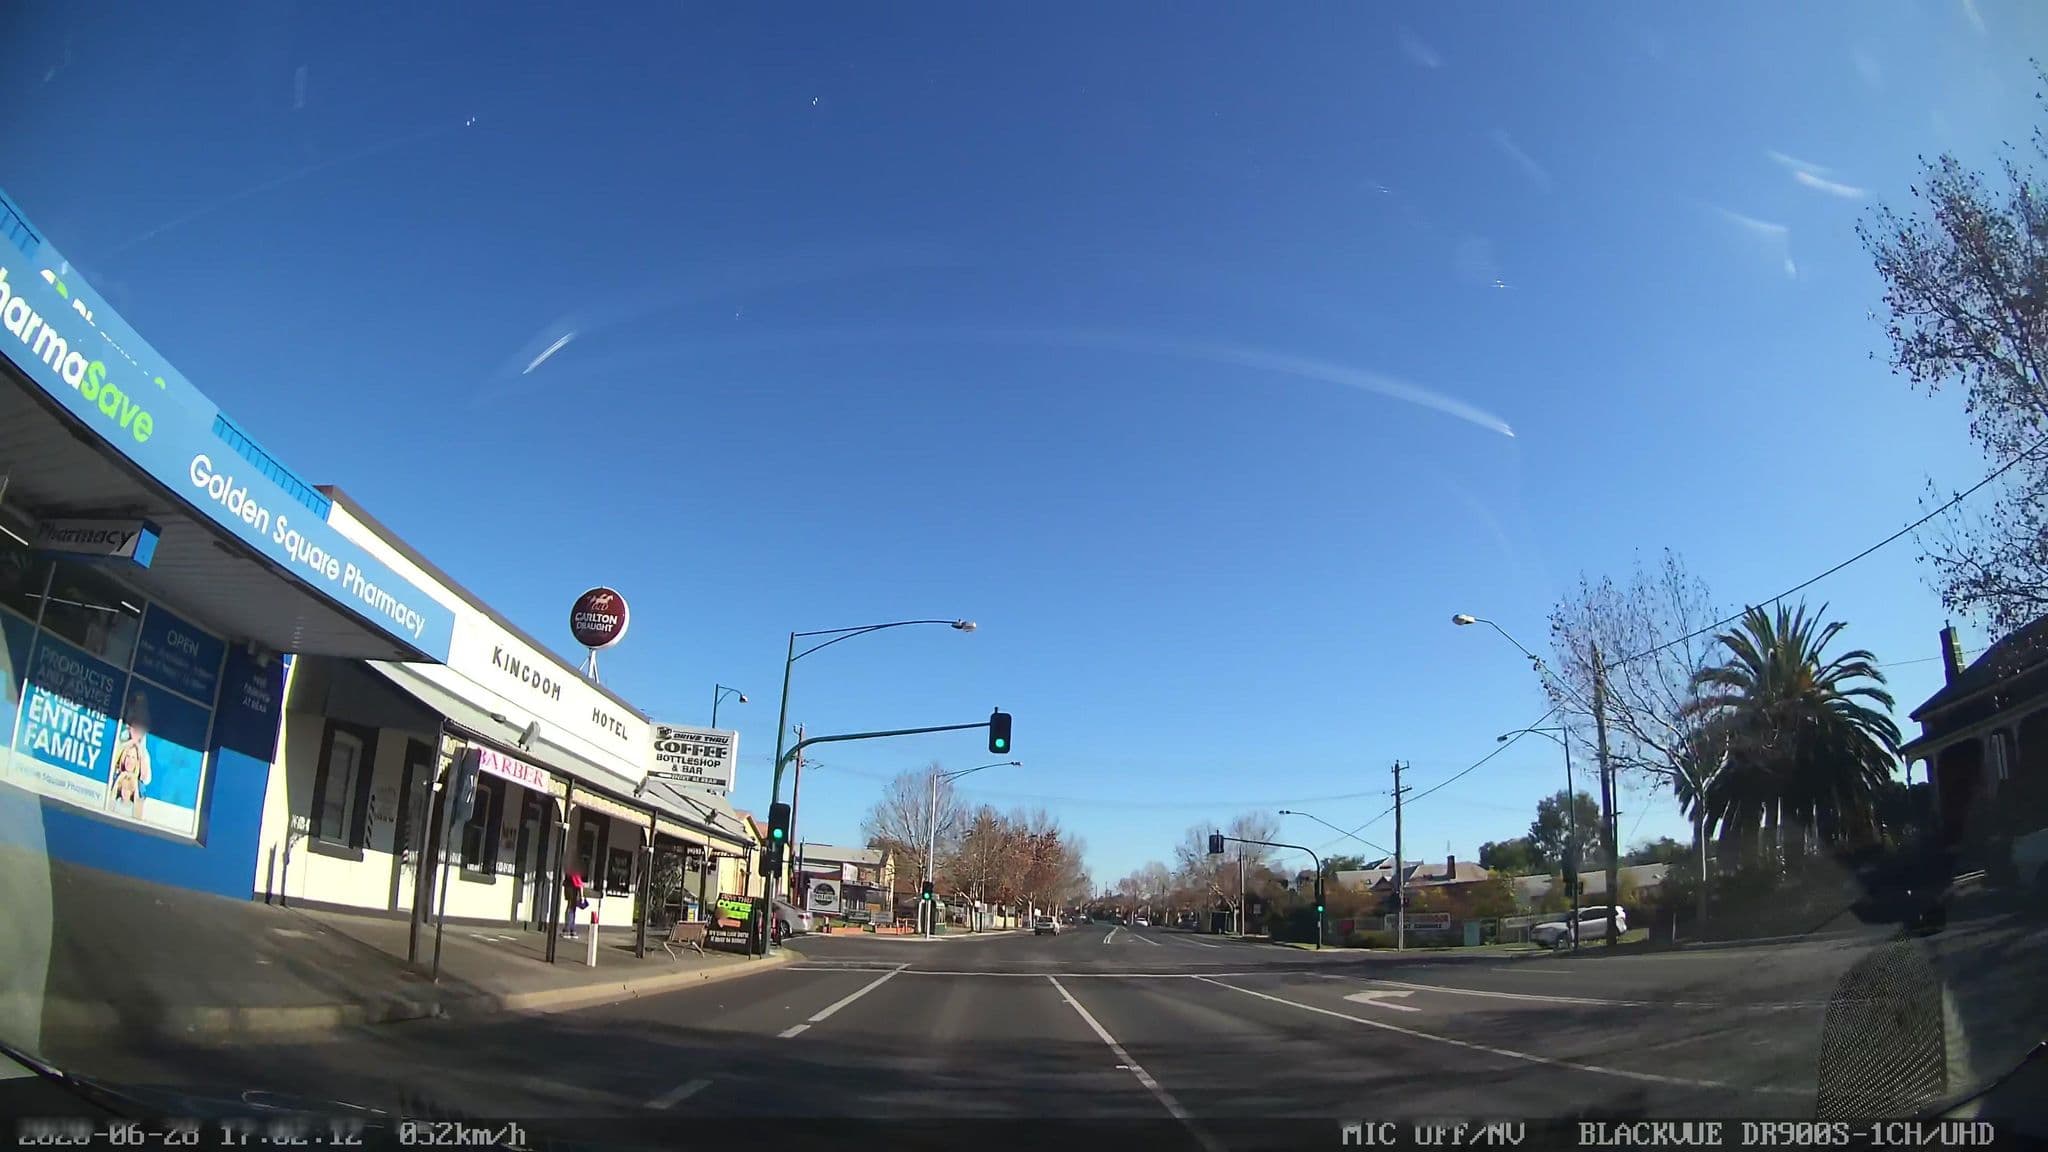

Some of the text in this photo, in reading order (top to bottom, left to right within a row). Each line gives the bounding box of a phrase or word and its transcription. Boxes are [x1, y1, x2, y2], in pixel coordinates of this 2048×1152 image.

[41, 521, 137, 552] Pharmacy
[189, 454, 426, 639] Golden Square Pharmacy
[575, 612, 618, 625] CARLTON
[576, 621, 614, 632] DRAUGHT
[167, 630, 200, 657] OPEN
[39, 645, 114, 693] PRODUCTS
[28, 694, 106, 747] ENTIRE
[592, 707, 628, 741] HOTEL
[23, 721, 102, 770] FAMILY
[654, 740, 728, 759] COFFEE
[673, 733, 729, 744] DRIVE THRU
[478, 746, 544, 787] BARBER
[656, 753, 722, 768] BOTTLESHOP
[682, 765, 703, 775] BAR
